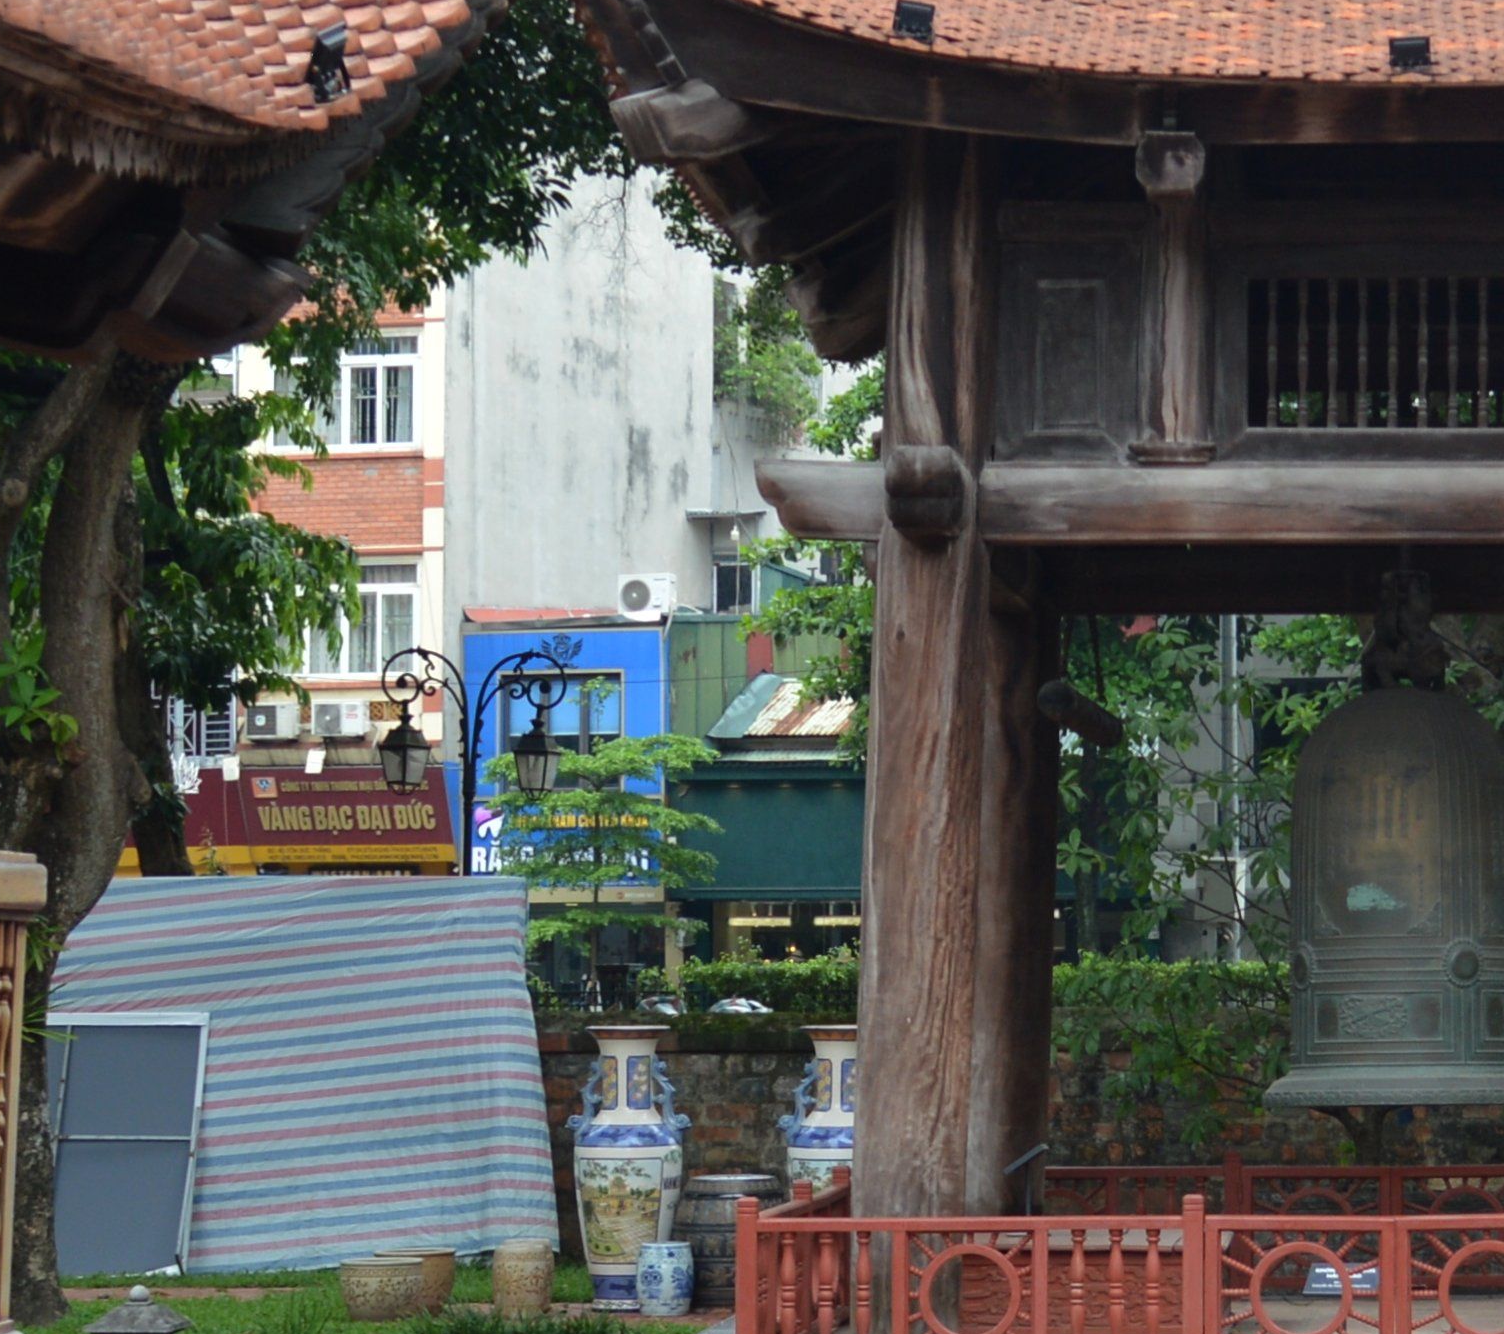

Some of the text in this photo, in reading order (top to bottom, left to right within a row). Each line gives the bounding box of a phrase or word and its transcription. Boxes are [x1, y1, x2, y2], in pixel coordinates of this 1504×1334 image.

[257, 798, 437, 835] VÀNG BẠC ĐẠI ĐỨC
